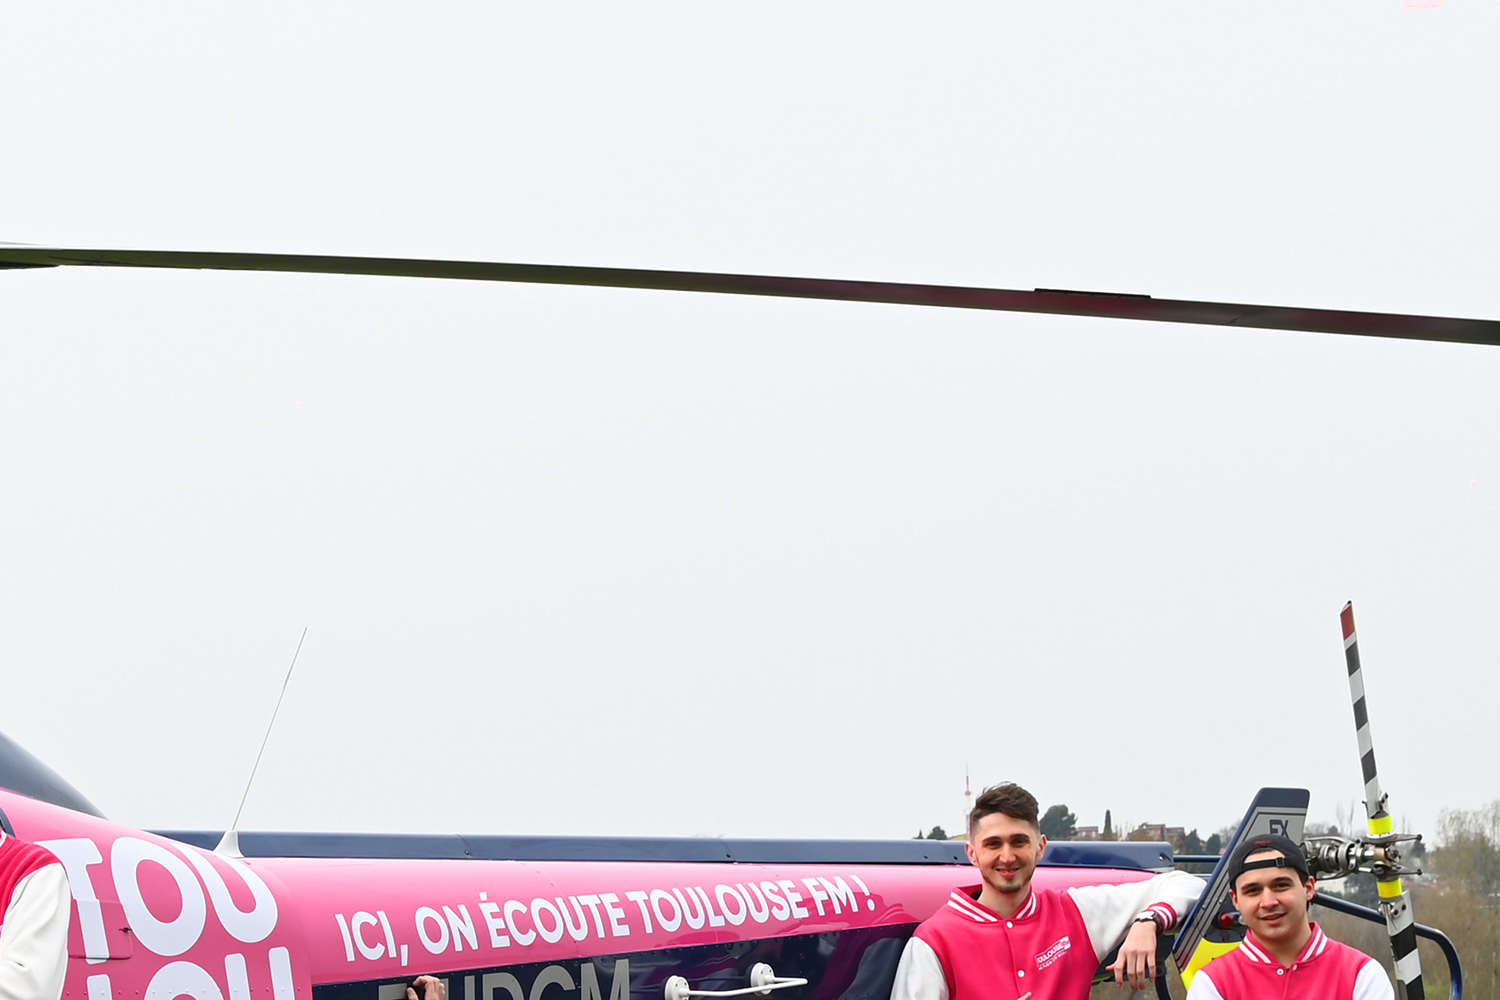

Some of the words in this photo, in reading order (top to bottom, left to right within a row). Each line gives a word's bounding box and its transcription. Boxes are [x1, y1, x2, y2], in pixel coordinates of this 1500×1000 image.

[34, 837, 278, 964] TOU
[335, 910, 409, 966] ICI,
[415, 904, 479, 954] ON
[478, 892, 631, 948] ÉCOUTE
[625, 880, 809, 934] TOULOUSE
[801, 876, 859, 917] FM
